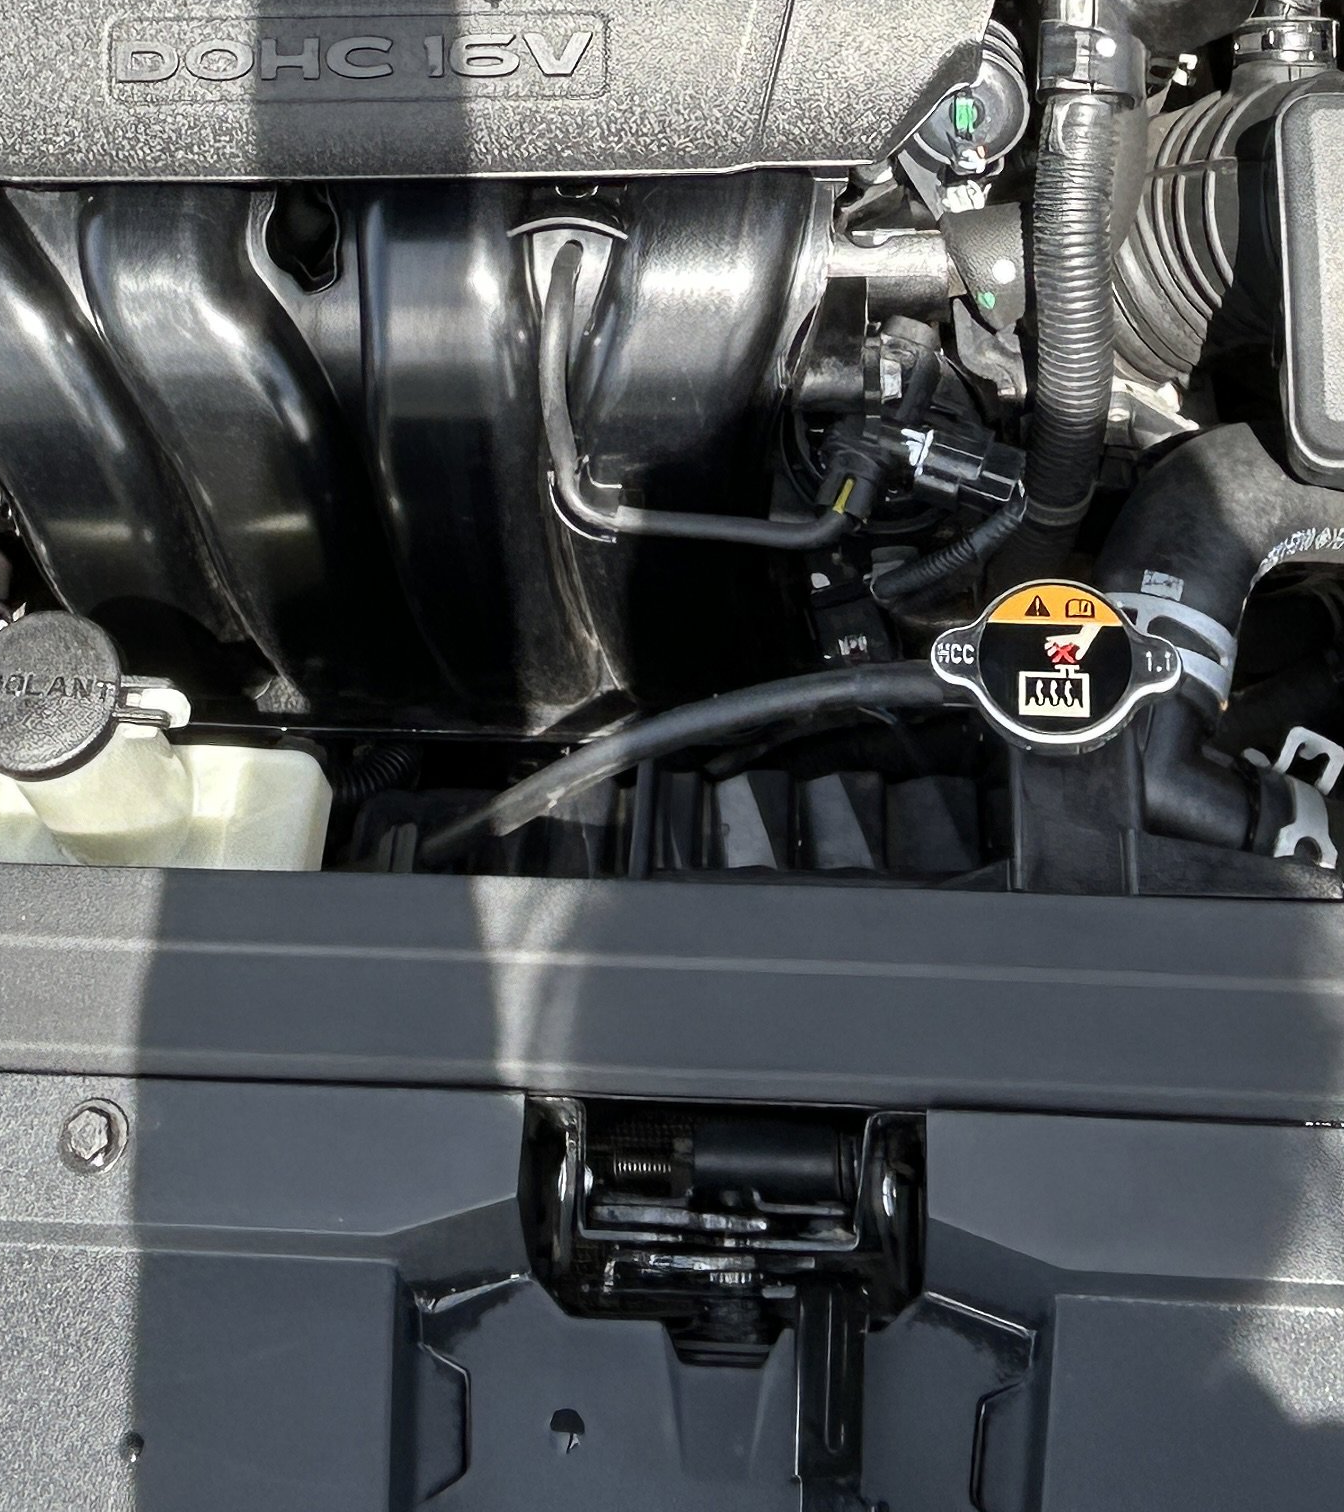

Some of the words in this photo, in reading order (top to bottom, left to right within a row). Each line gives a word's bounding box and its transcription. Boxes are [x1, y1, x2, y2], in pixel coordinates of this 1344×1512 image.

[115, 34, 394, 83] DOHC
[423, 31, 593, 79] 16V
[936, 642, 975, 665] HCC
[1145, 650, 1172, 673] 1.1
